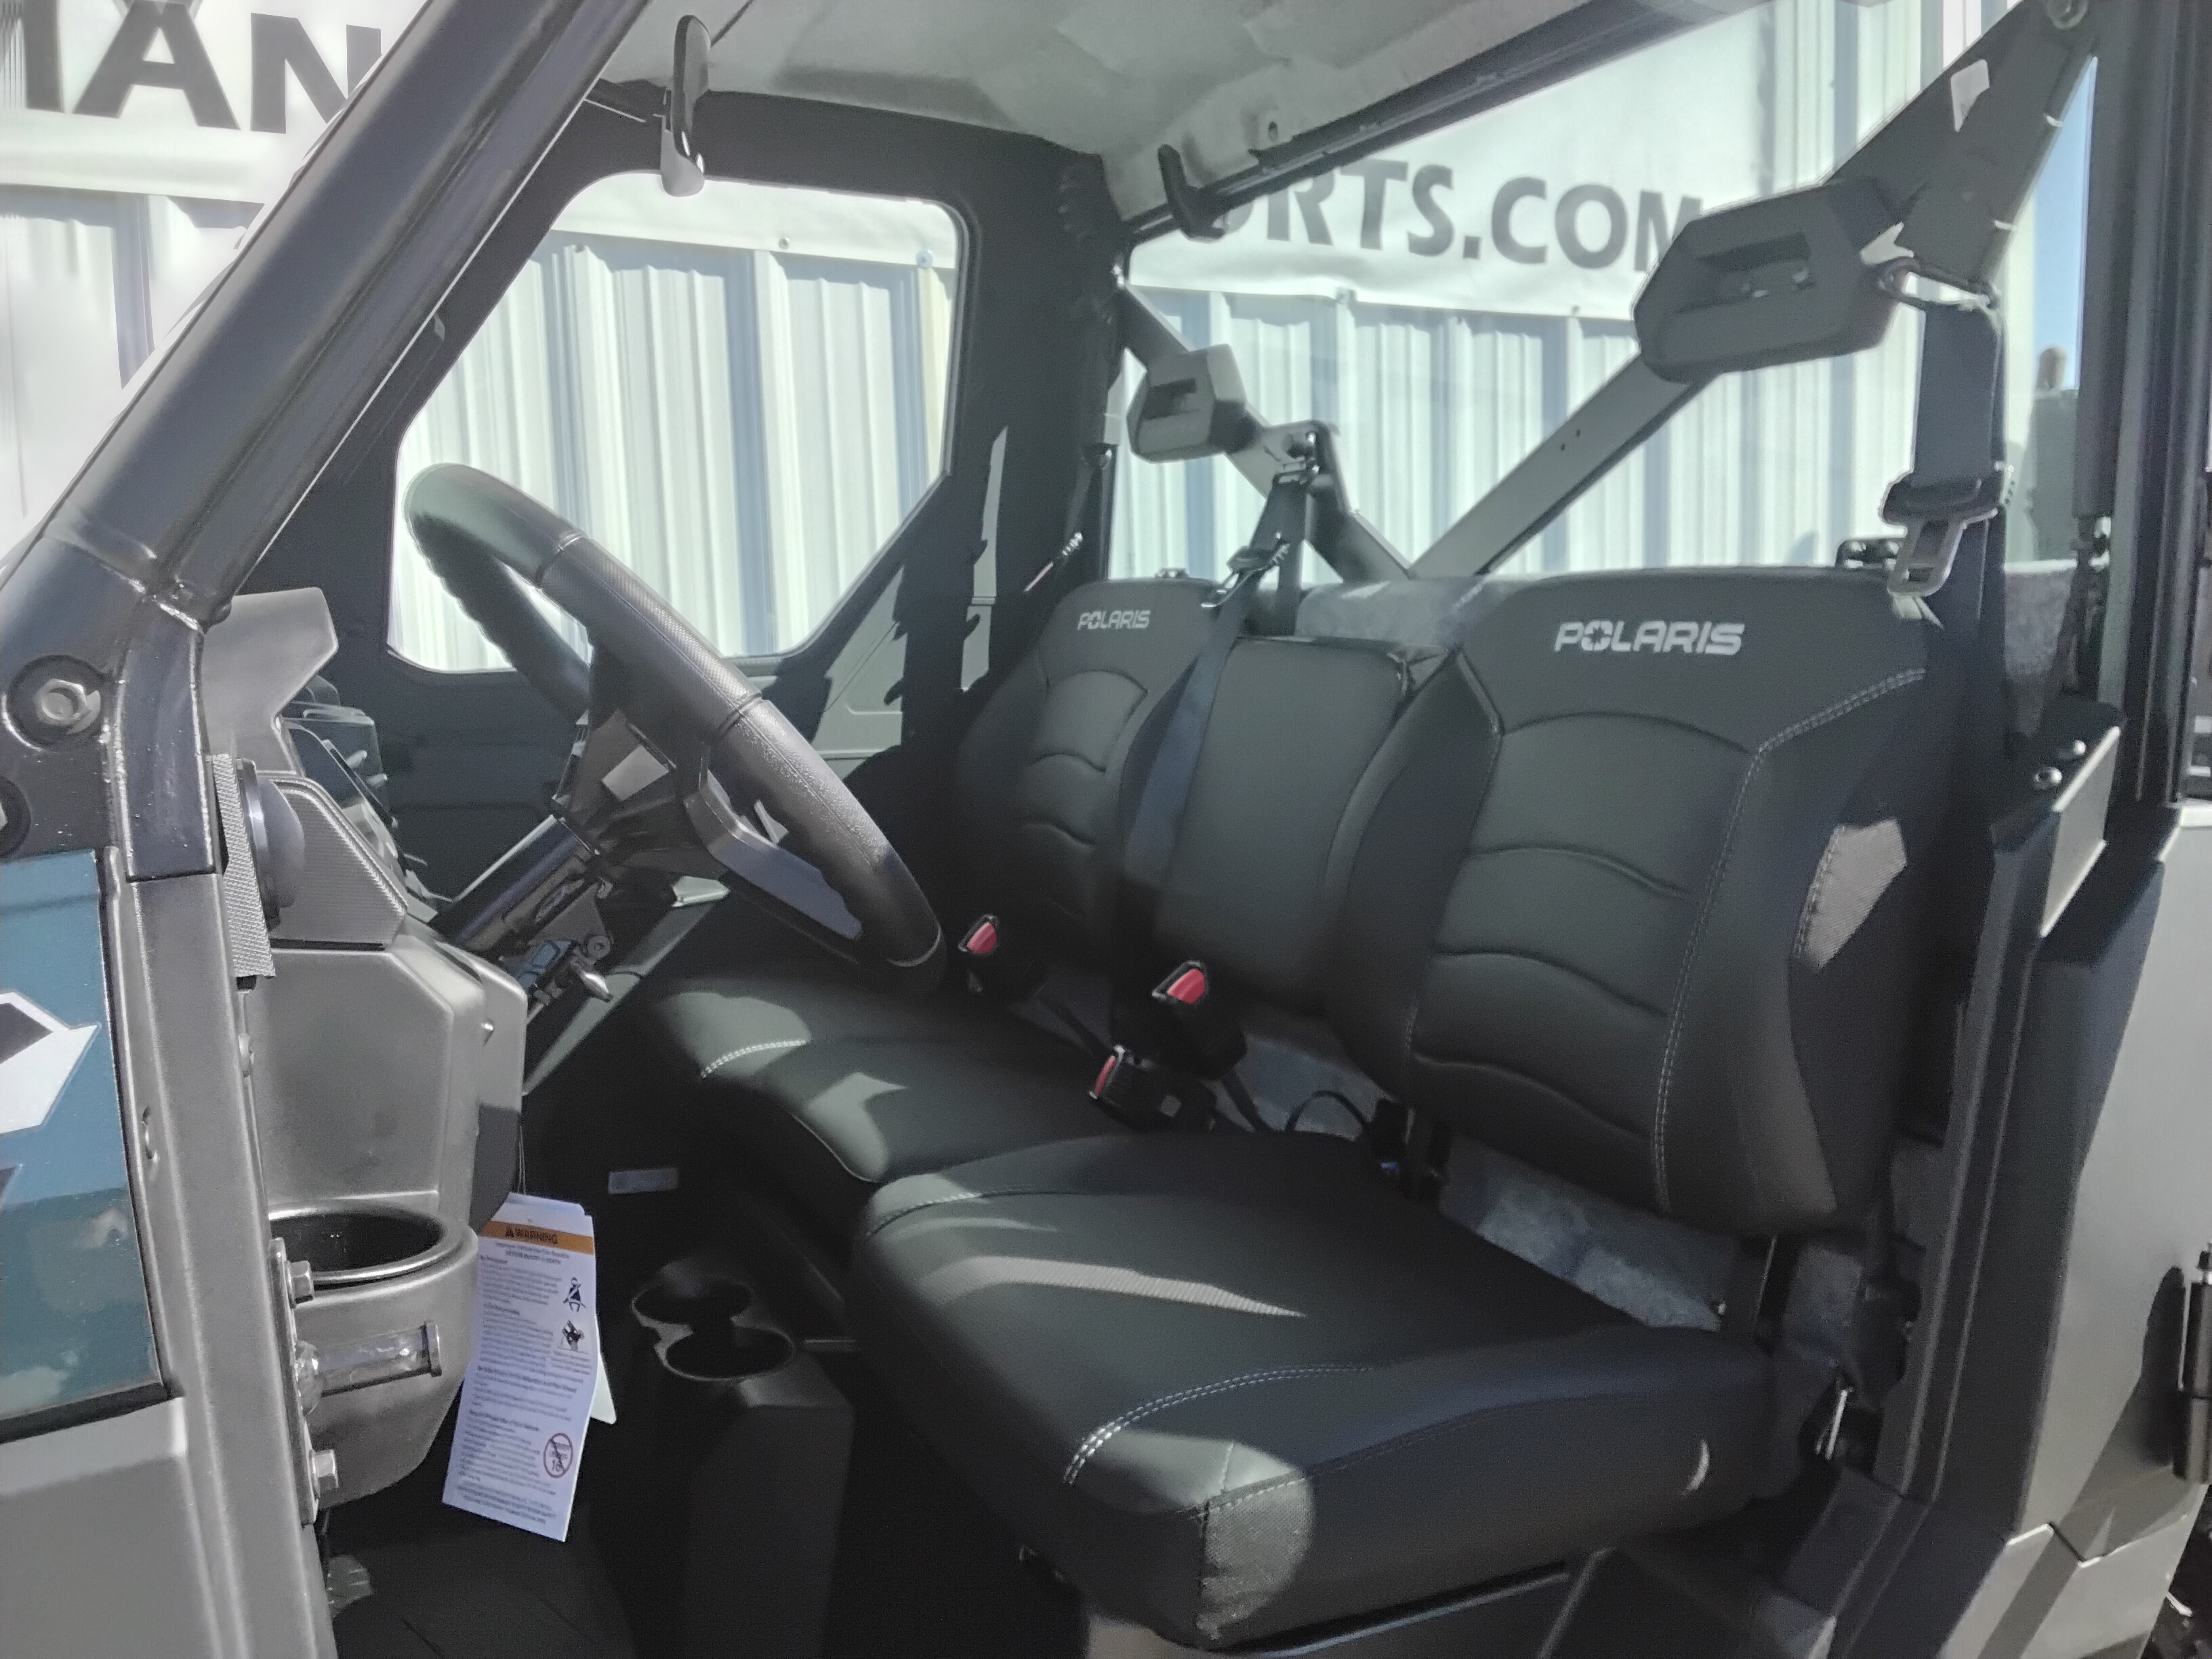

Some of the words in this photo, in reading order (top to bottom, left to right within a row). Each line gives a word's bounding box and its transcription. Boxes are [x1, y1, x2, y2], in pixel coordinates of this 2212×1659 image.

[1224, 159, 1702, 272] RTS.COM
[1077, 610, 1151, 631] POLARIS
[1554, 620, 1745, 655] POLARIS
